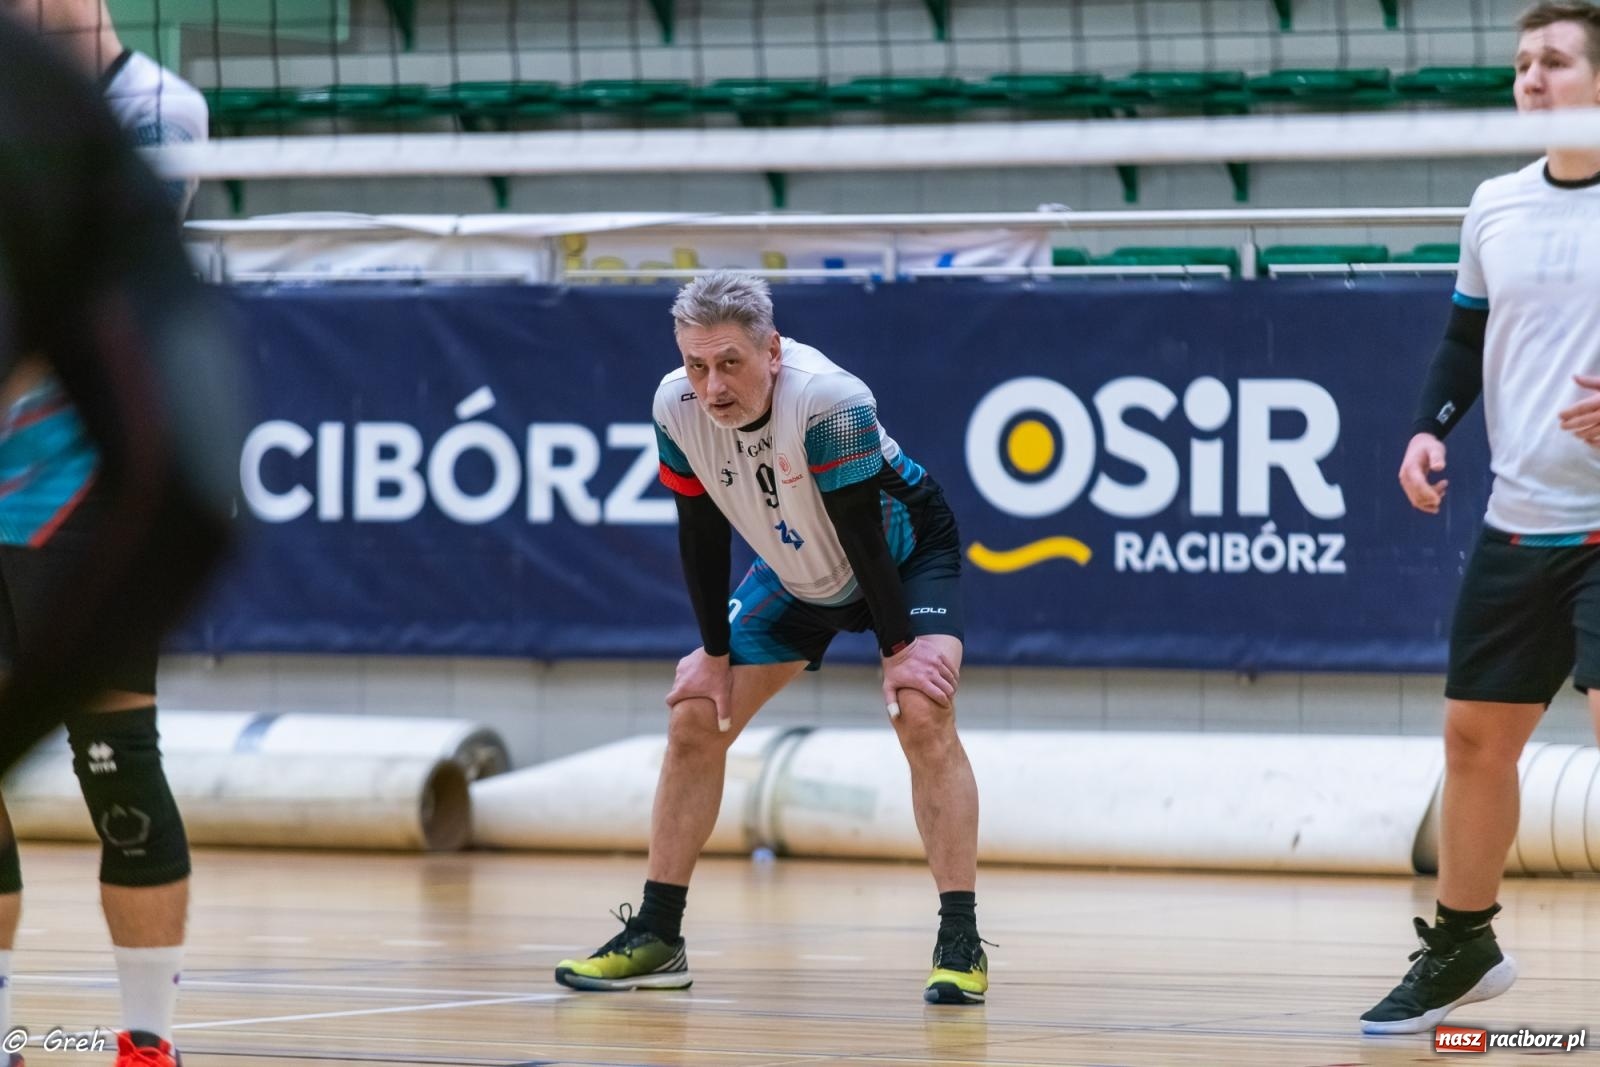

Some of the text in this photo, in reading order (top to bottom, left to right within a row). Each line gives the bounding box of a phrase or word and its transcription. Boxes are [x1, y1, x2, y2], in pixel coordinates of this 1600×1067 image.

[239, 385, 678, 524] CIBÓRZ
[755, 463, 780, 509] 9
[965, 375, 1347, 520] OSiR
[1114, 519, 1347, 574] RACIBÓRZ
